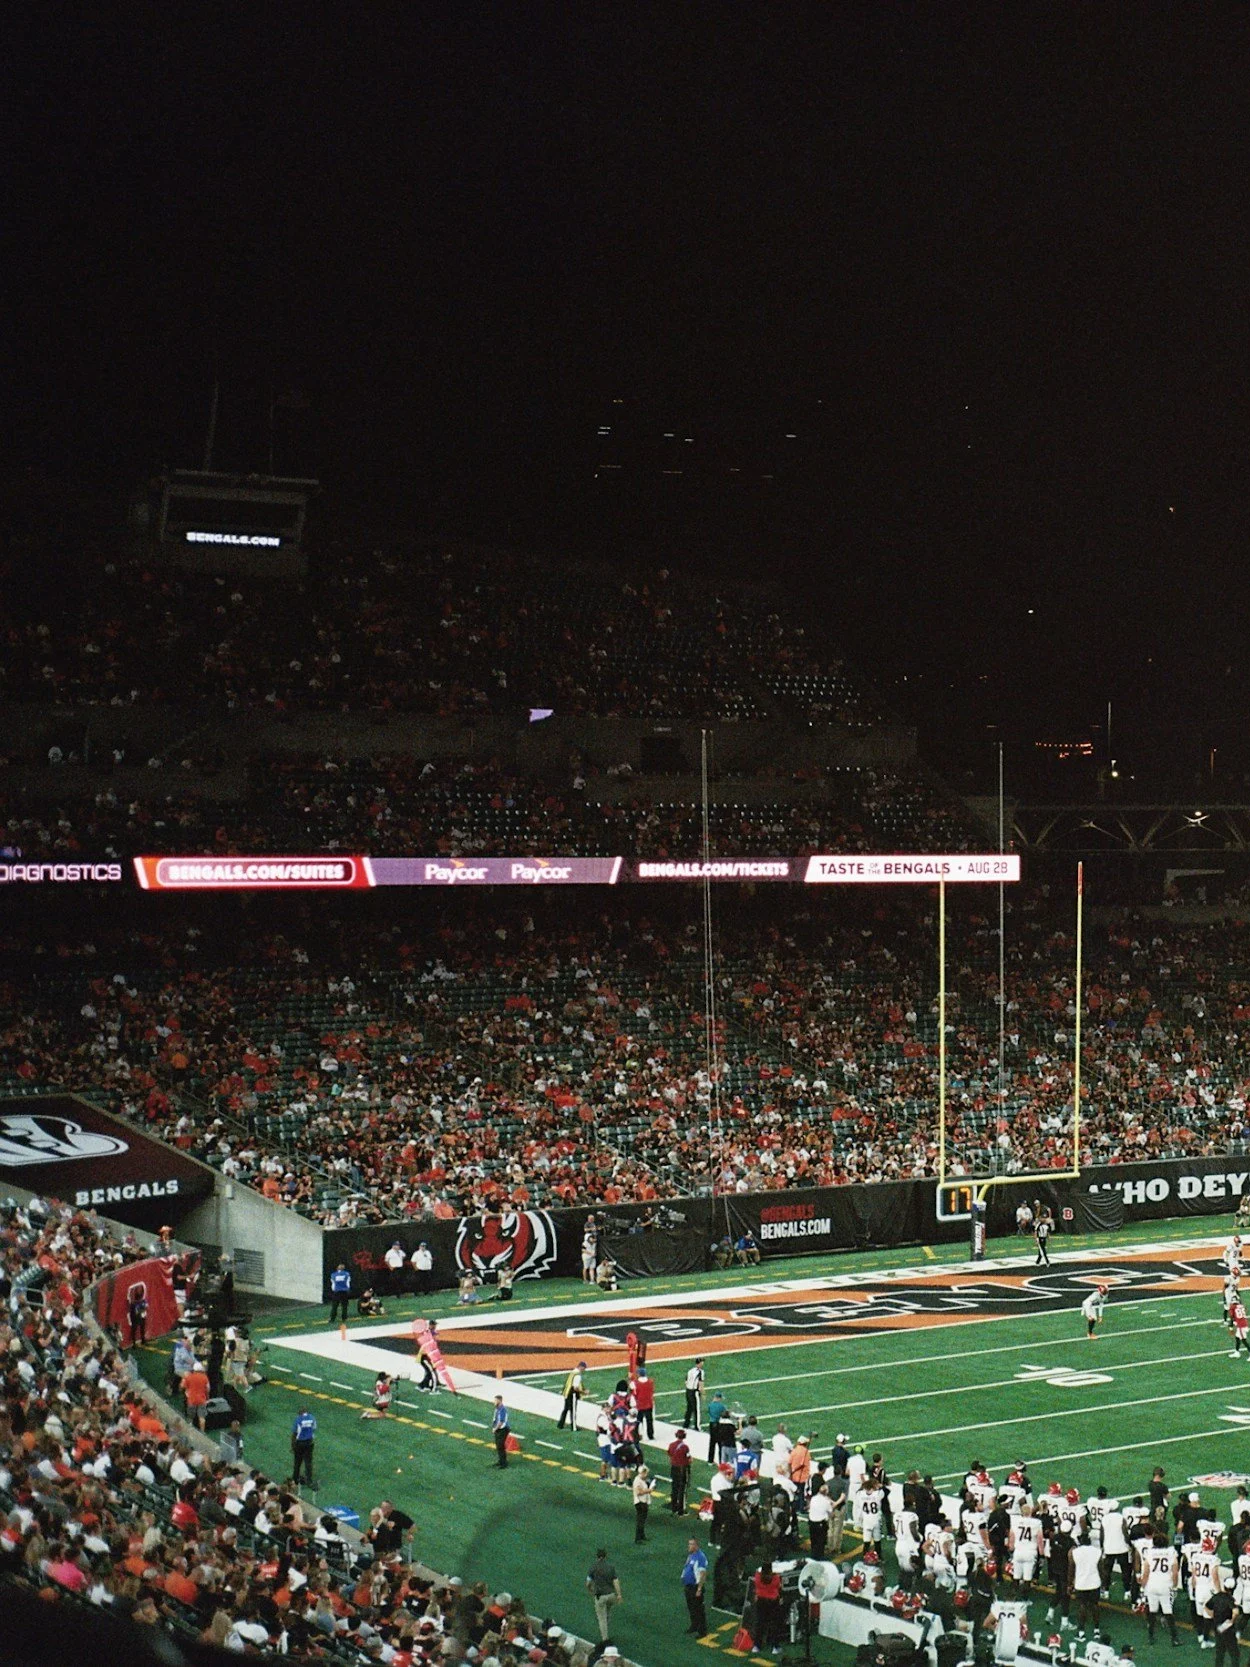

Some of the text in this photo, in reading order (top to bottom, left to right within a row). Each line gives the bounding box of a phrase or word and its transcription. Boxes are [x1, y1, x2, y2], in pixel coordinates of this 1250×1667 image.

[186, 532, 280, 546] BENGALS.COM
[168, 863, 346, 880] BENGALS.COM/SUITES
[425, 863, 488, 885] Paycor
[511, 863, 571, 884] Paycor
[638, 861, 789, 877] BENGALS.COM/TICKETS
[819, 862, 865, 875] TASTE
[884, 862, 950, 874] BENGALS
[967, 862, 990, 874] AUG
[993, 862, 1008, 873] 28
[75, 1180, 179, 1206] BENGALS
[950, 1187, 971, 1213] 17
[761, 1218, 831, 1240] BENGALS.COM
[862, 1502, 878, 1515] 48
[1018, 1526, 1032, 1541] 74
[1152, 1557, 1169, 1573] 76
